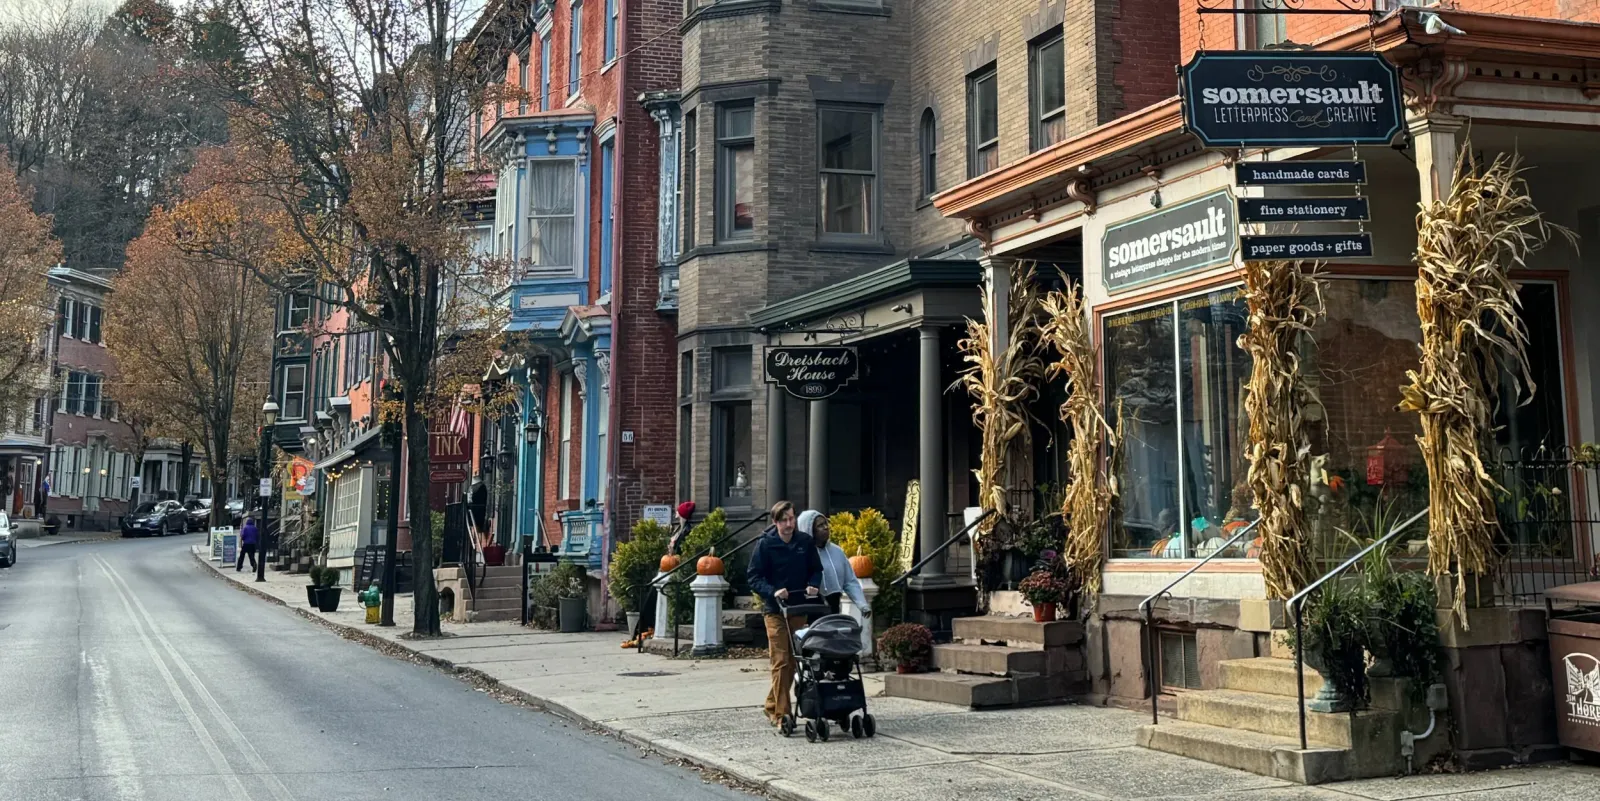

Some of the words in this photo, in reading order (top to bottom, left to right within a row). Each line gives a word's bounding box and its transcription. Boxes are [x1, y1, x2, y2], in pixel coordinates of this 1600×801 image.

[1202, 80, 1384, 104] somersault
[1214, 107, 1289, 123] LETTERPRESS
[1326, 106, 1377, 122] CREATIVE
[1252, 169, 1314, 180] handmade
[1317, 168, 1350, 179] cards
[1260, 205, 1284, 215] fine
[1287, 204, 1347, 217] stationery
[1108, 206, 1227, 268] somersault
[1174, 252, 1182, 262] for
[1182, 250, 1191, 259] the
[1191, 245, 1212, 257] modern
[1251, 244, 1285, 256] paper
[1289, 241, 1324, 254] goods
[1335, 240, 1363, 253] gifts
[774, 350, 850, 367] Dreisbach
[786, 366, 837, 381] House
[805, 385, 822, 394] 1899
[434, 434, 463, 456] INK
